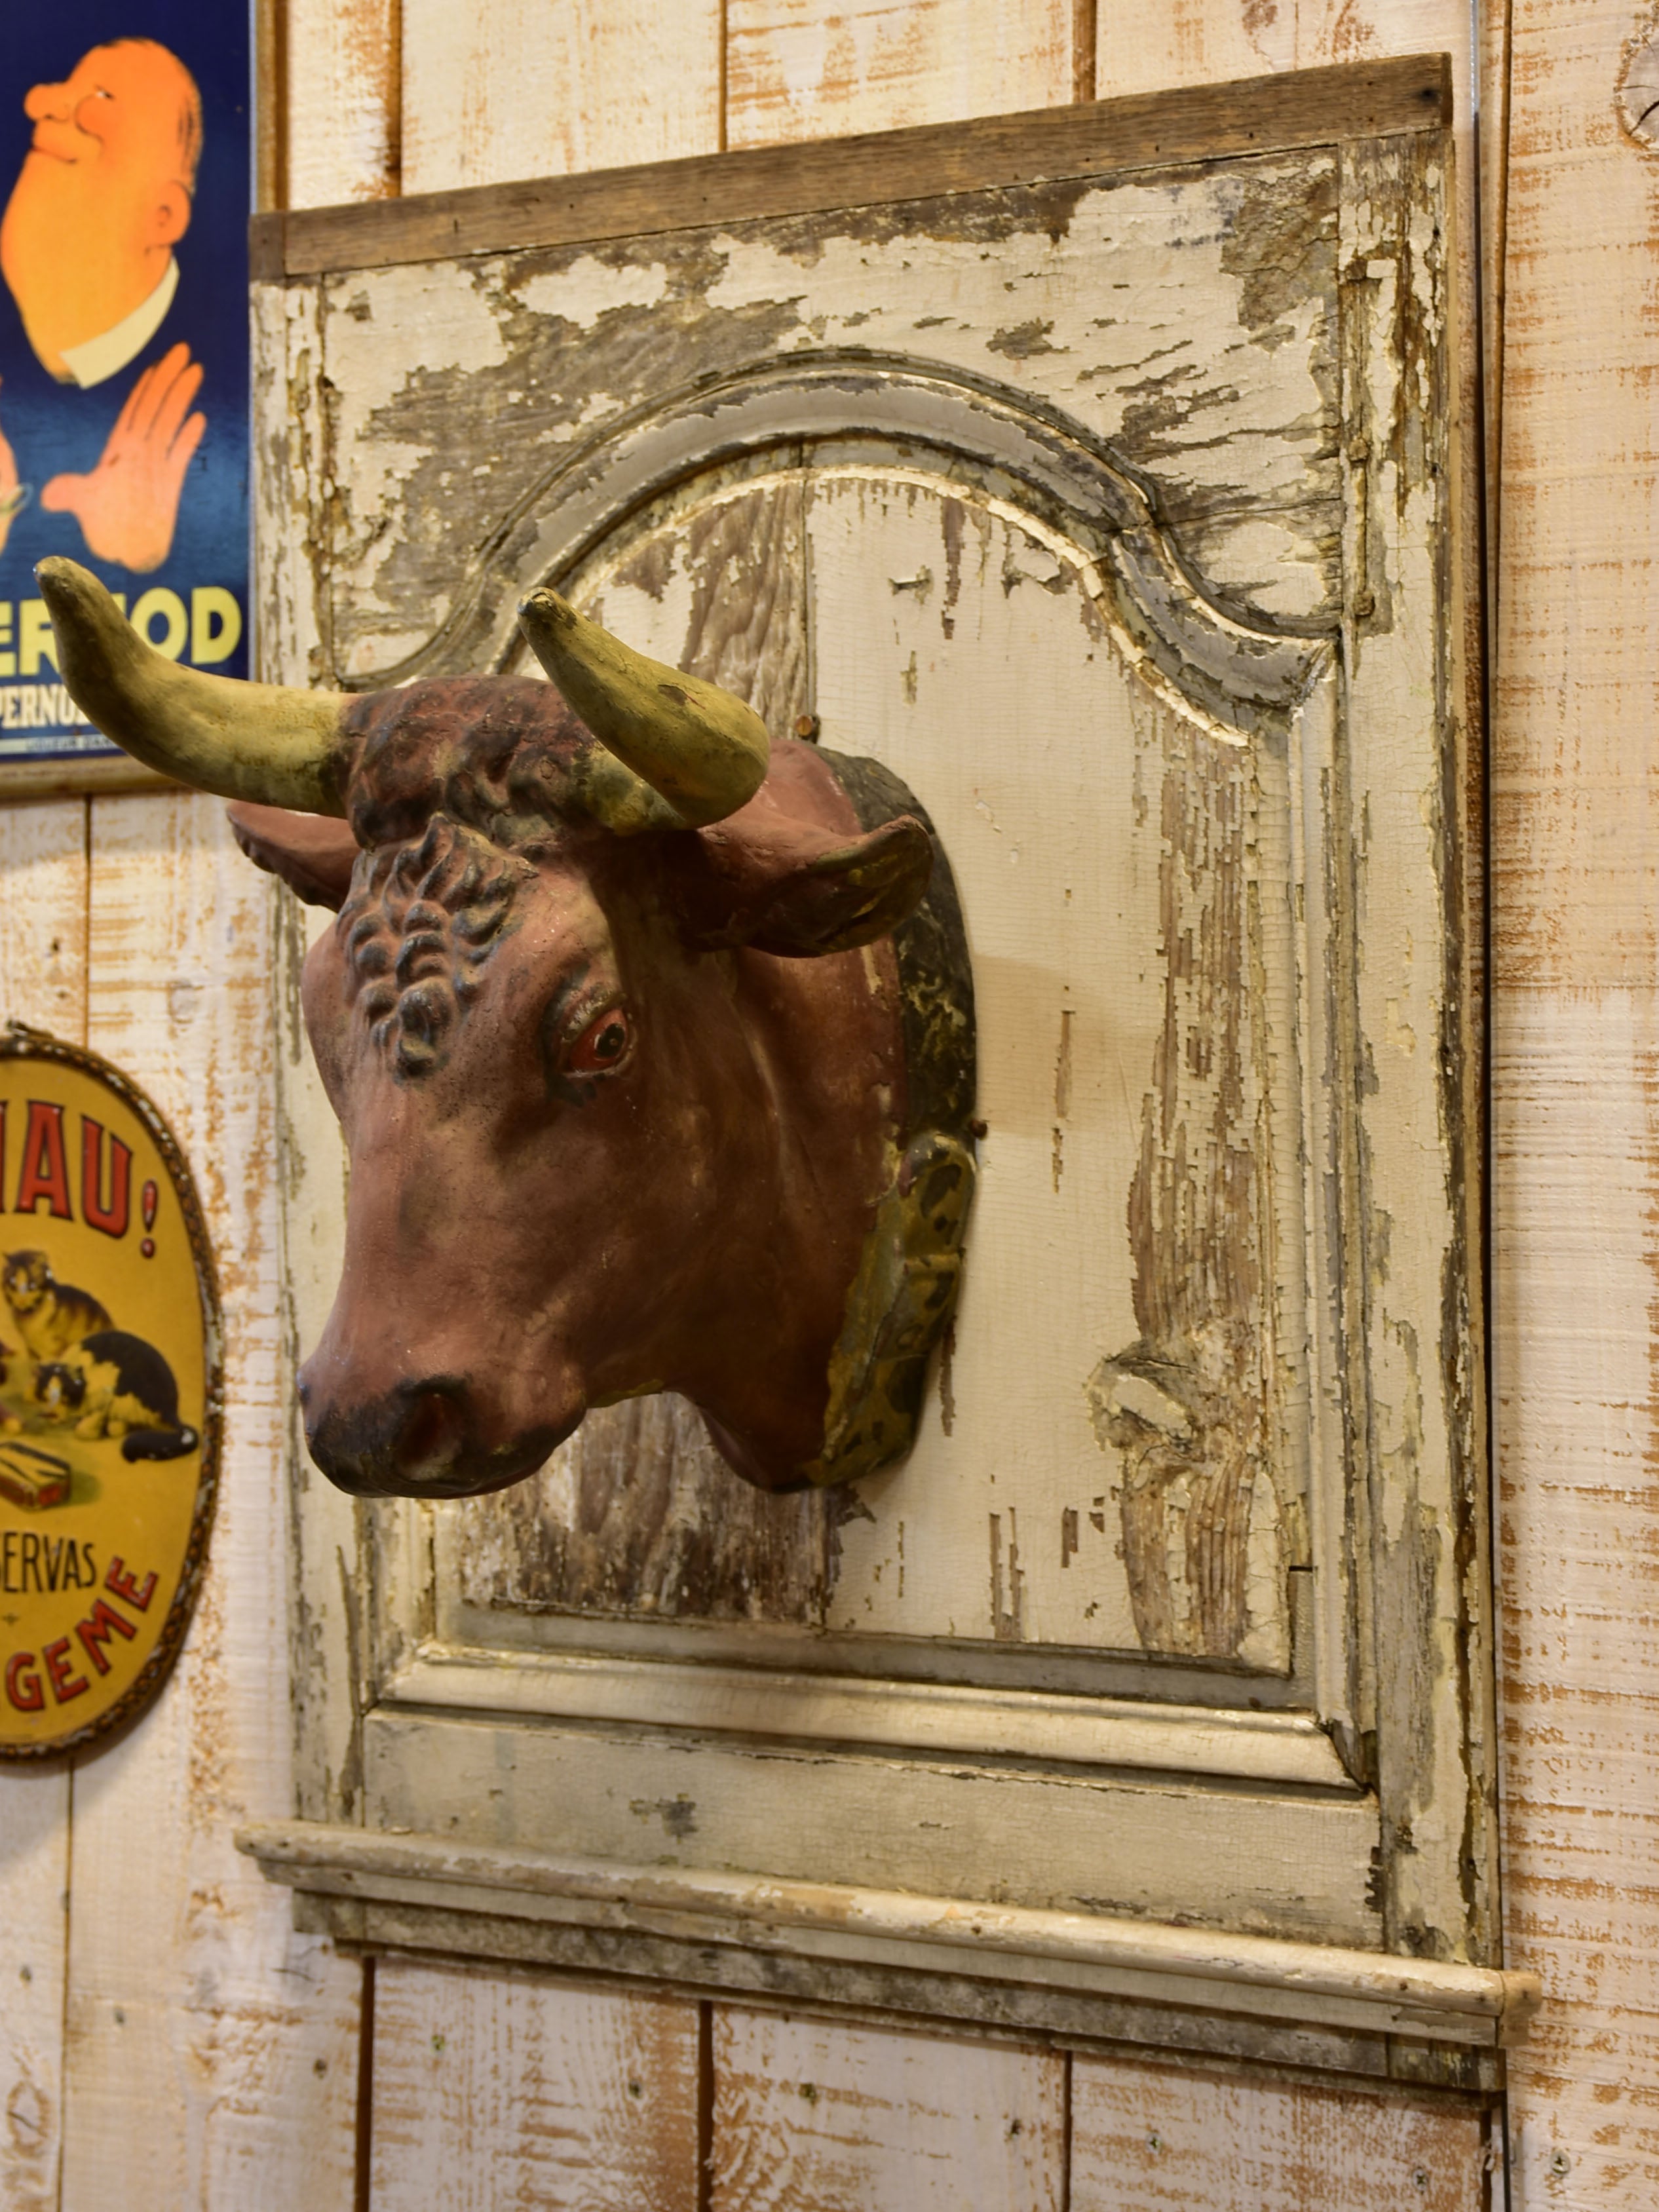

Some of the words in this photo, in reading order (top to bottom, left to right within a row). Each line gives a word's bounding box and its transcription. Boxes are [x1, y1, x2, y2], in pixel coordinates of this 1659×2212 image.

[0, 586, 242, 676] EROD
[0, 1099, 158, 1258] AU!
[4, 1531, 97, 1593] ERVAS
[5, 1555, 159, 1711] GEME
